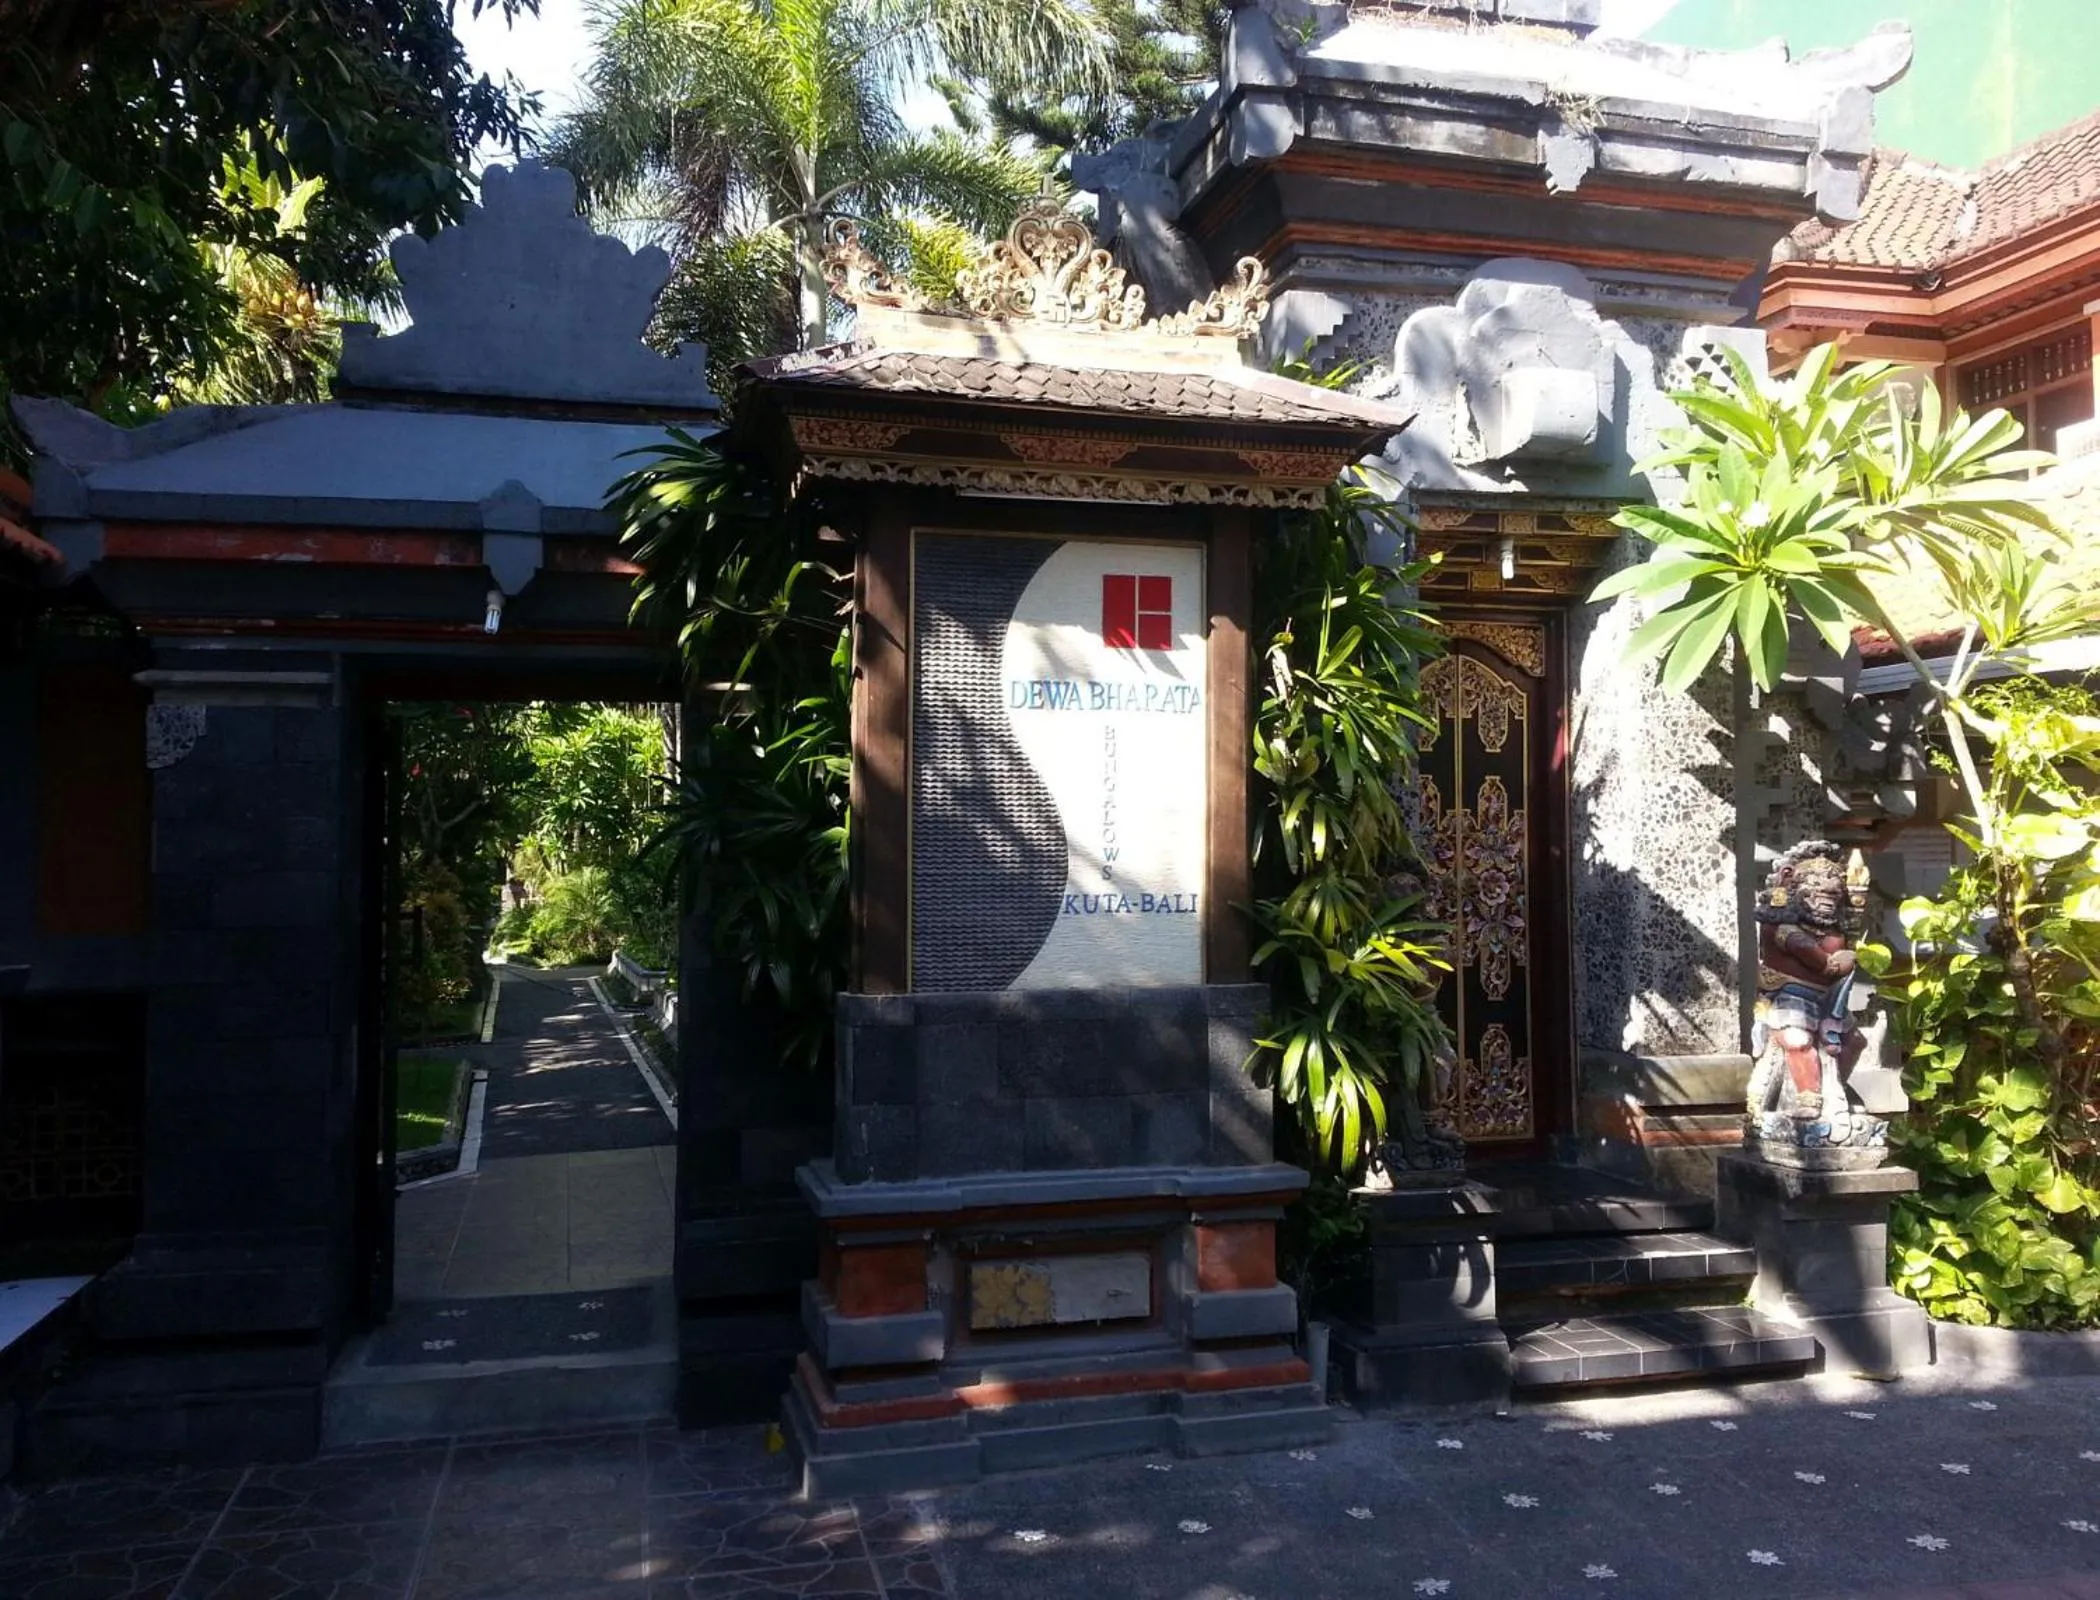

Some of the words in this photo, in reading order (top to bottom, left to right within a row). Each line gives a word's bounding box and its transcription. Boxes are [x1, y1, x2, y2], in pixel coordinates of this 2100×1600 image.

[1009, 680, 1083, 711] DEWA
[1088, 680, 1202, 714] BHARATA
[1062, 893, 1198, 915] KUTA-BALI
